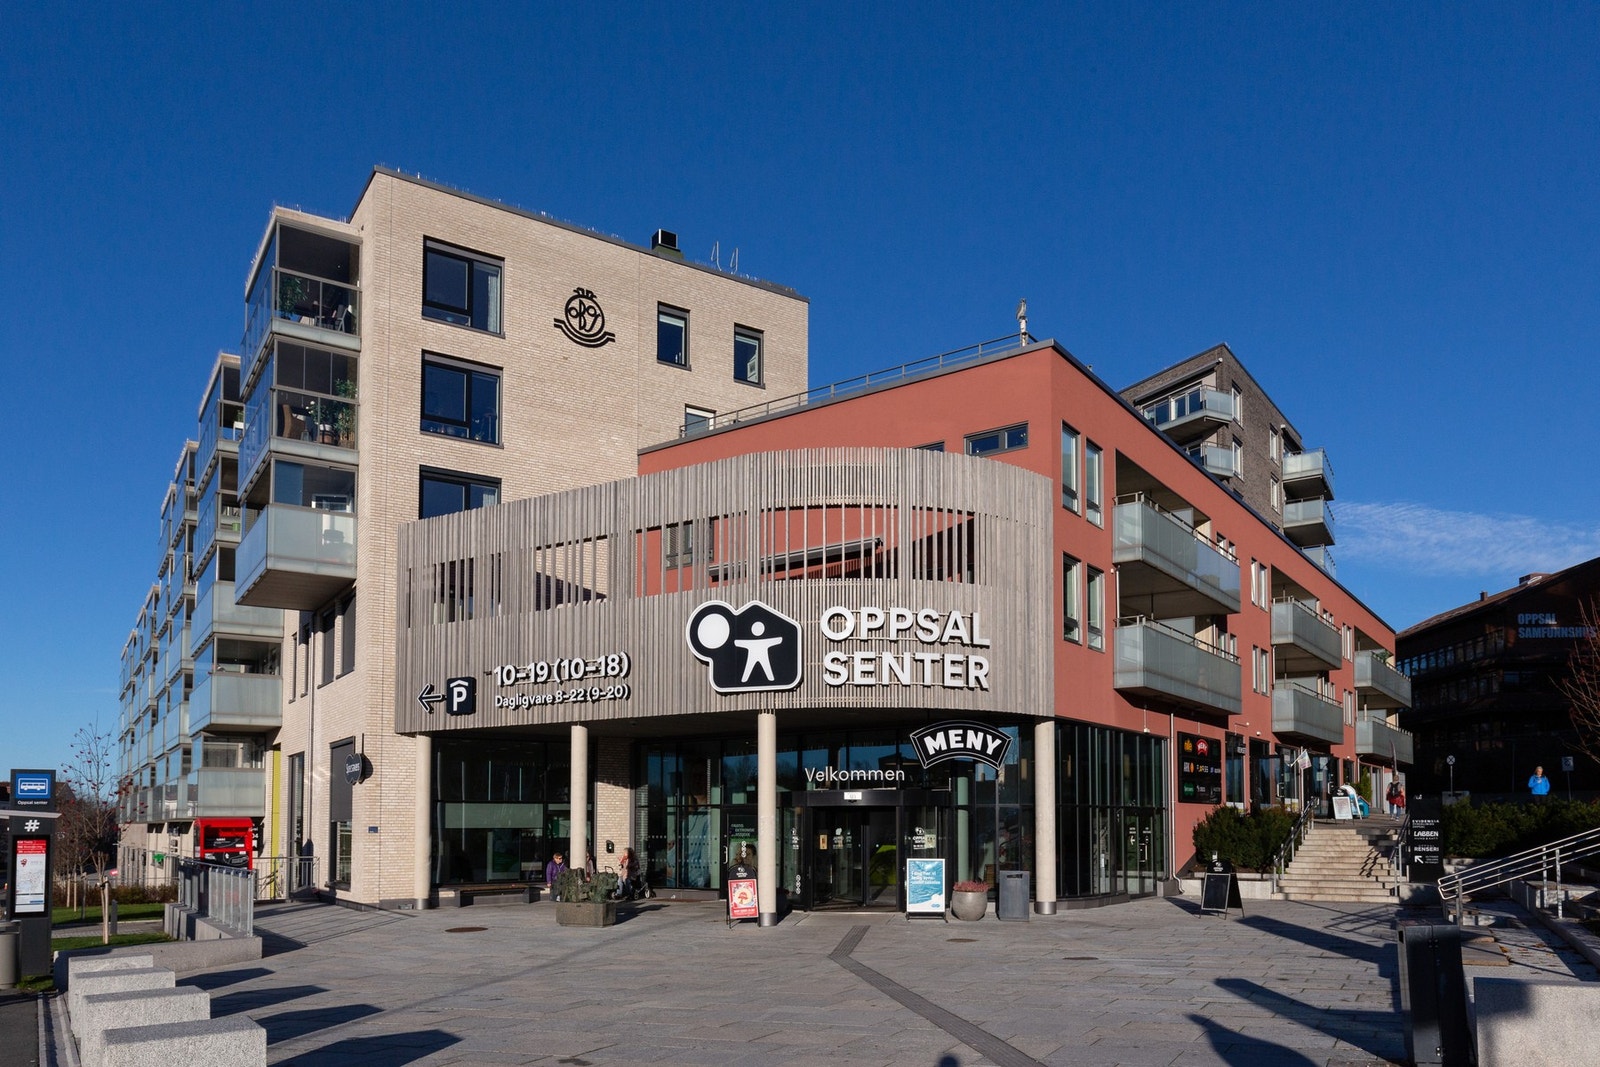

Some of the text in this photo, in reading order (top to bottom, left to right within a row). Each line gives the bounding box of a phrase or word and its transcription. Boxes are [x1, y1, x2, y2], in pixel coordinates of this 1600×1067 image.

[820, 606, 991, 648] OPPSAL
[1517, 612, 1557, 625] OPPSAL
[822, 651, 990, 691] SENTER
[452, 686, 467, 711] P
[494, 692, 553, 710] Dagligvare
[923, 729, 1002, 756] MENY
[804, 766, 905, 782] Velkommen
